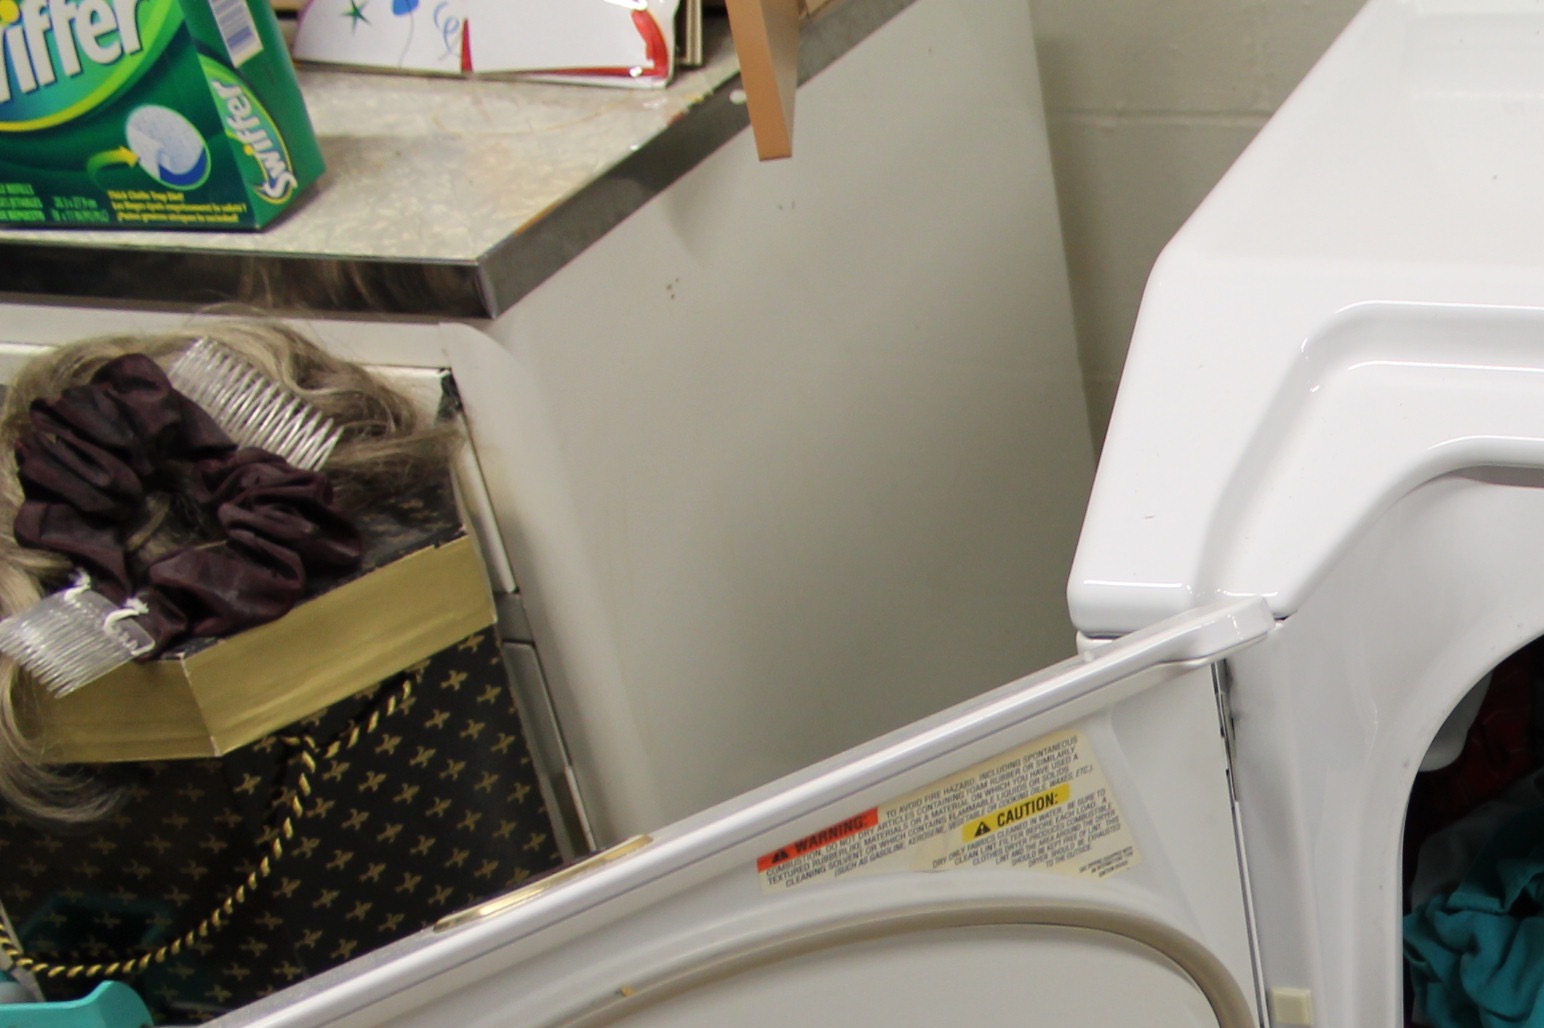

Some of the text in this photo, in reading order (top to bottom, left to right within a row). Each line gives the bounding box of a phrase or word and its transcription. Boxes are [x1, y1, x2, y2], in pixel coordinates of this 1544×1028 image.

[0, 0, 143, 101] iffer
[211, 79, 298, 199] Swiffer
[826, 842, 837, 853] DO
[840, 836, 855, 847] NOT
[859, 828, 874, 839] DRY
[877, 812, 914, 832] ARTICLES
[917, 791, 964, 815] CONTAINING
[967, 782, 988, 795] FOAM
[991, 768, 1021, 786] RUBBER
[1023, 763, 1034, 773] OR
[1036, 746, 1075, 767] SIMILARLY
[886, 809, 897, 820] TO
[899, 799, 922, 814] AVOID
[925, 791, 940, 803] FIRE
[980, 759, 1020, 781] INCLUDING
[1023, 736, 1077, 763] SPONTANEOUS
[997, 790, 1060, 828] CAUTION:
[769, 863, 810, 886] TEXTURED
[864, 823, 908, 846] MATERIALS
[910, 817, 922, 828] OR
[971, 792, 983, 803] ON
[985, 782, 1010, 796] WHICH
[1014, 775, 1028, 785] YOU
[1030, 766, 1049, 778] HAVE
[1052, 756, 1071, 770] USED
[1072, 753, 1079, 761] A
[786, 766, 1069, 888] CLEANING SOLVENT OR WHICH CONTAINS FLAMMABLE LIQUIDS OR SOLIDS
[795, 815, 867, 854] WARNING:
[949, 848, 965, 861] ONLY
[968, 835, 995, 852] FABRICS
[998, 821, 1028, 839] CLEANED
[1030, 817, 1037, 825] IN
[1078, 793, 1095, 805] SURE
[1097, 787, 1106, 797] TO
[955, 851, 978, 866] CLEAN
[981, 843, 997, 855] LINT
[999, 832, 1023, 847] FILTER
[1026, 819, 1053, 836] BEFORE
[1056, 810, 1074, 823] EACH
[1101, 796, 1107, 804] A
[973, 802, 1112, 866] CLOTHES DRYER PRODUCES COMBUSTIBLE
[996, 809, 1115, 865] LINT AND THE AREA AROUND THE DRYER
[1088, 823, 1121, 842] EXHAUSTED
[858, 857, 868, 867] AS
[1012, 851, 1036, 866] SHOULD
